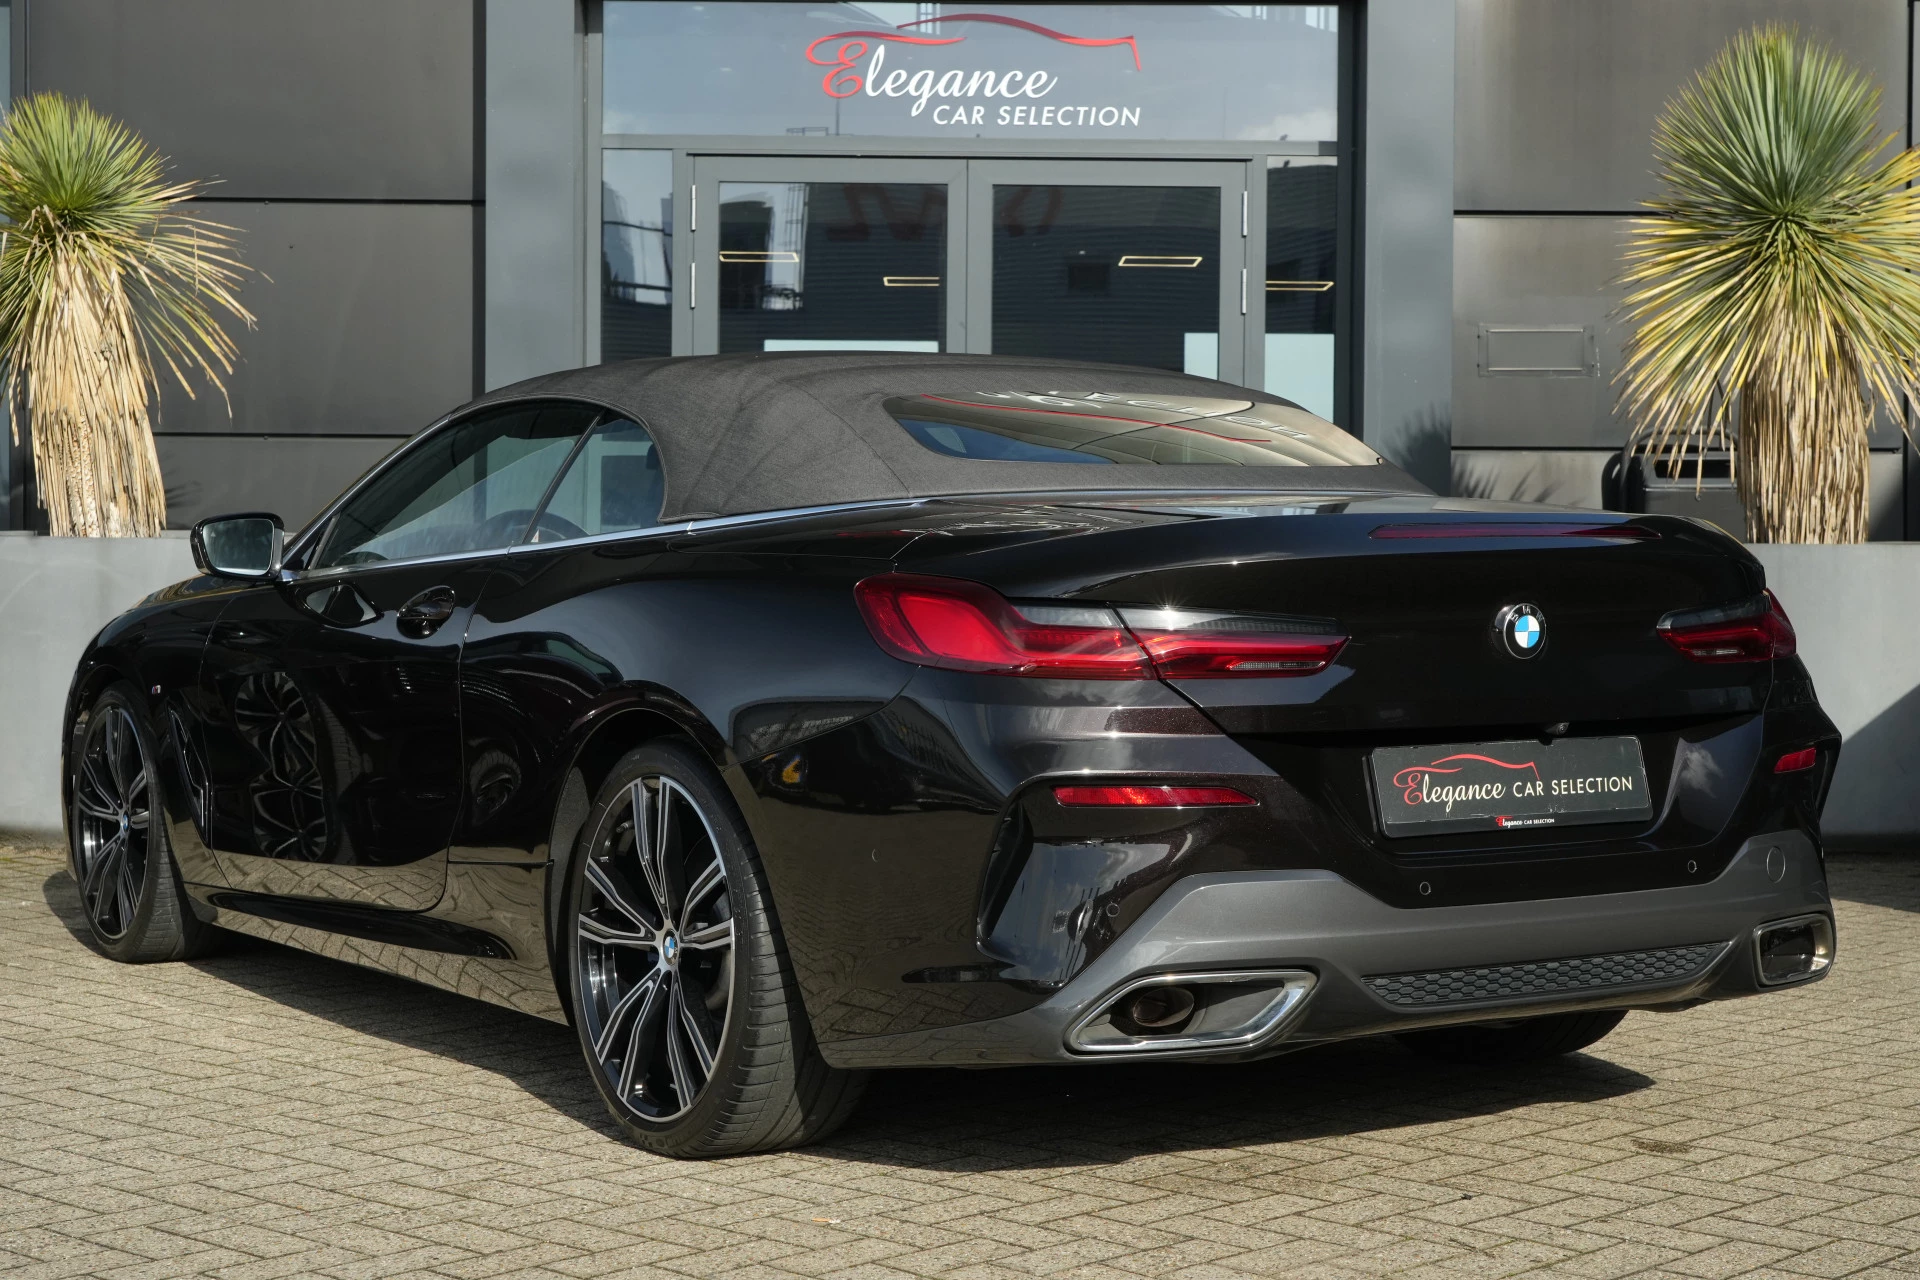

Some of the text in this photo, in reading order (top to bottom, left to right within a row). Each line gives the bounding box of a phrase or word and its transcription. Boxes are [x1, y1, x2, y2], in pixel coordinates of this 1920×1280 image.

[806, 31, 1058, 117] Elegance
[933, 105, 1141, 127] CAR SELECTION
[1393, 767, 1633, 813] Elegance CAR SELECTION
[1495, 815, 1523, 829] Elegance
